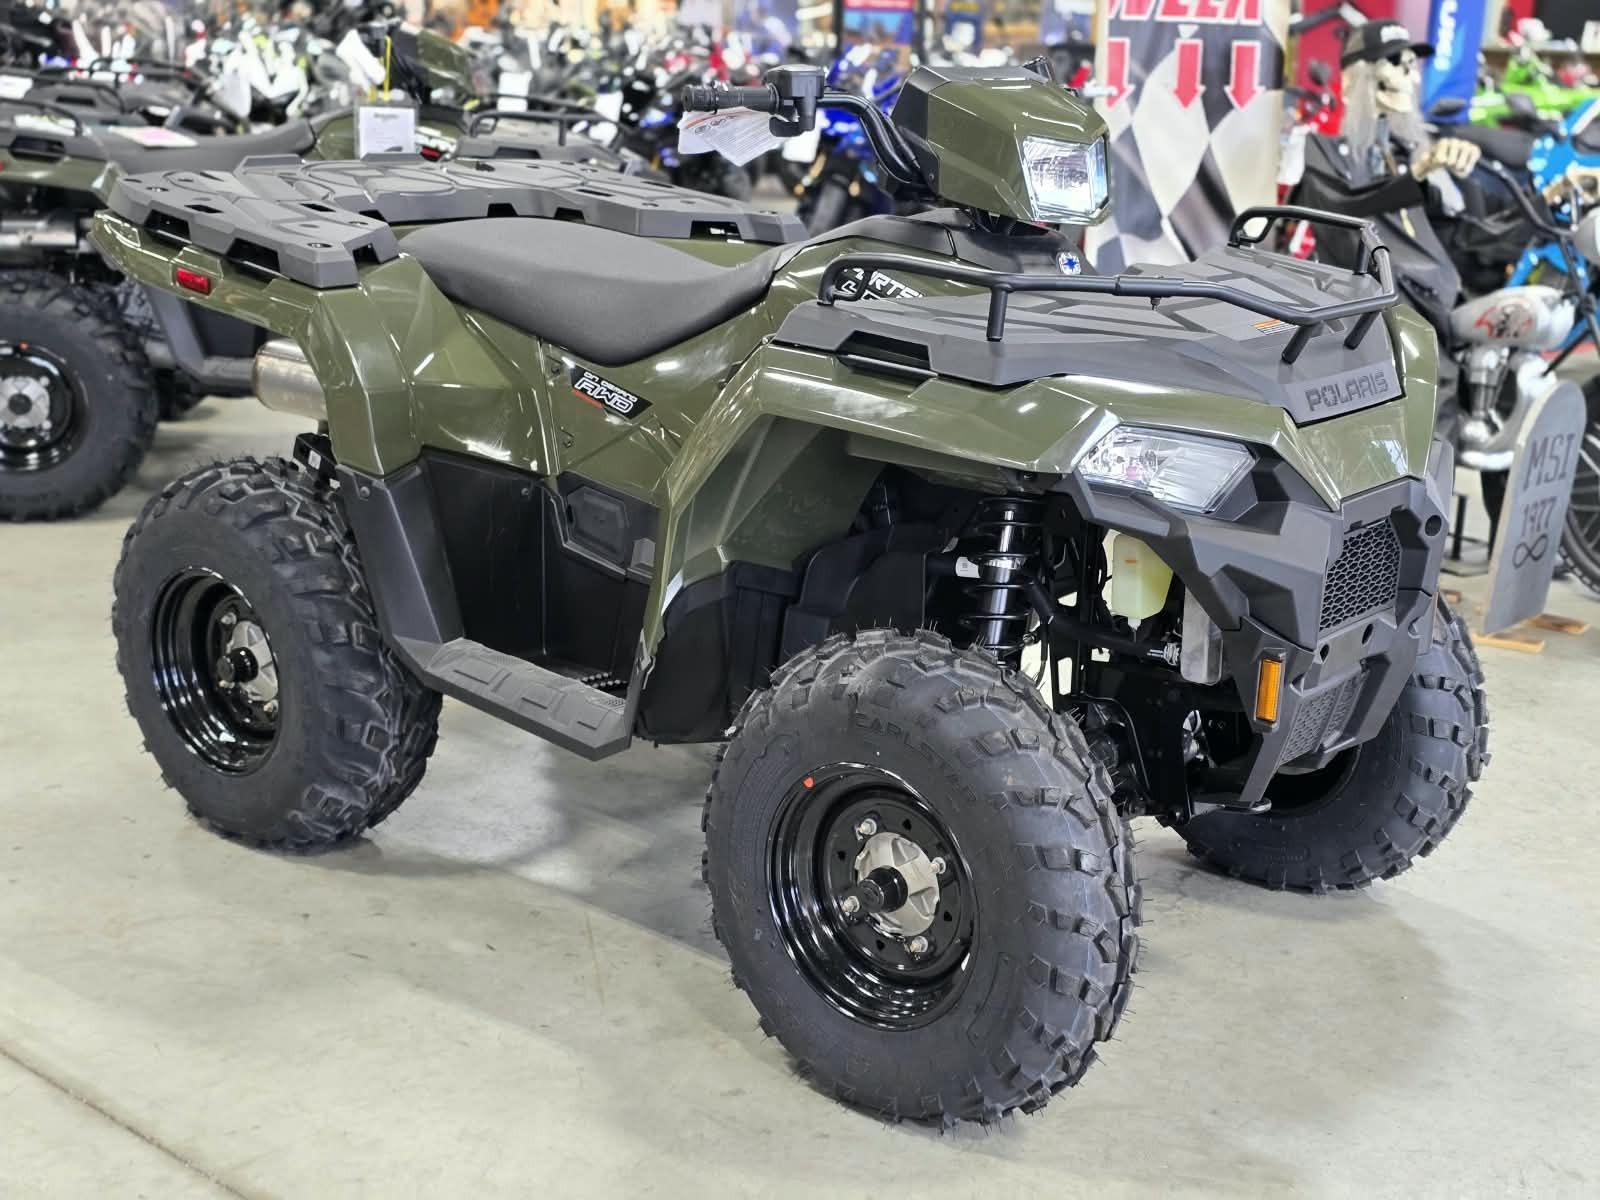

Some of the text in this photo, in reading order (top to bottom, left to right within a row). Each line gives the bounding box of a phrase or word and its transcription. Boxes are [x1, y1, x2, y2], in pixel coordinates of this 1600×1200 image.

[574, 376, 634, 414] AWD
[1305, 371, 1389, 412] POLARIS
[1523, 433, 1576, 491] MSI
